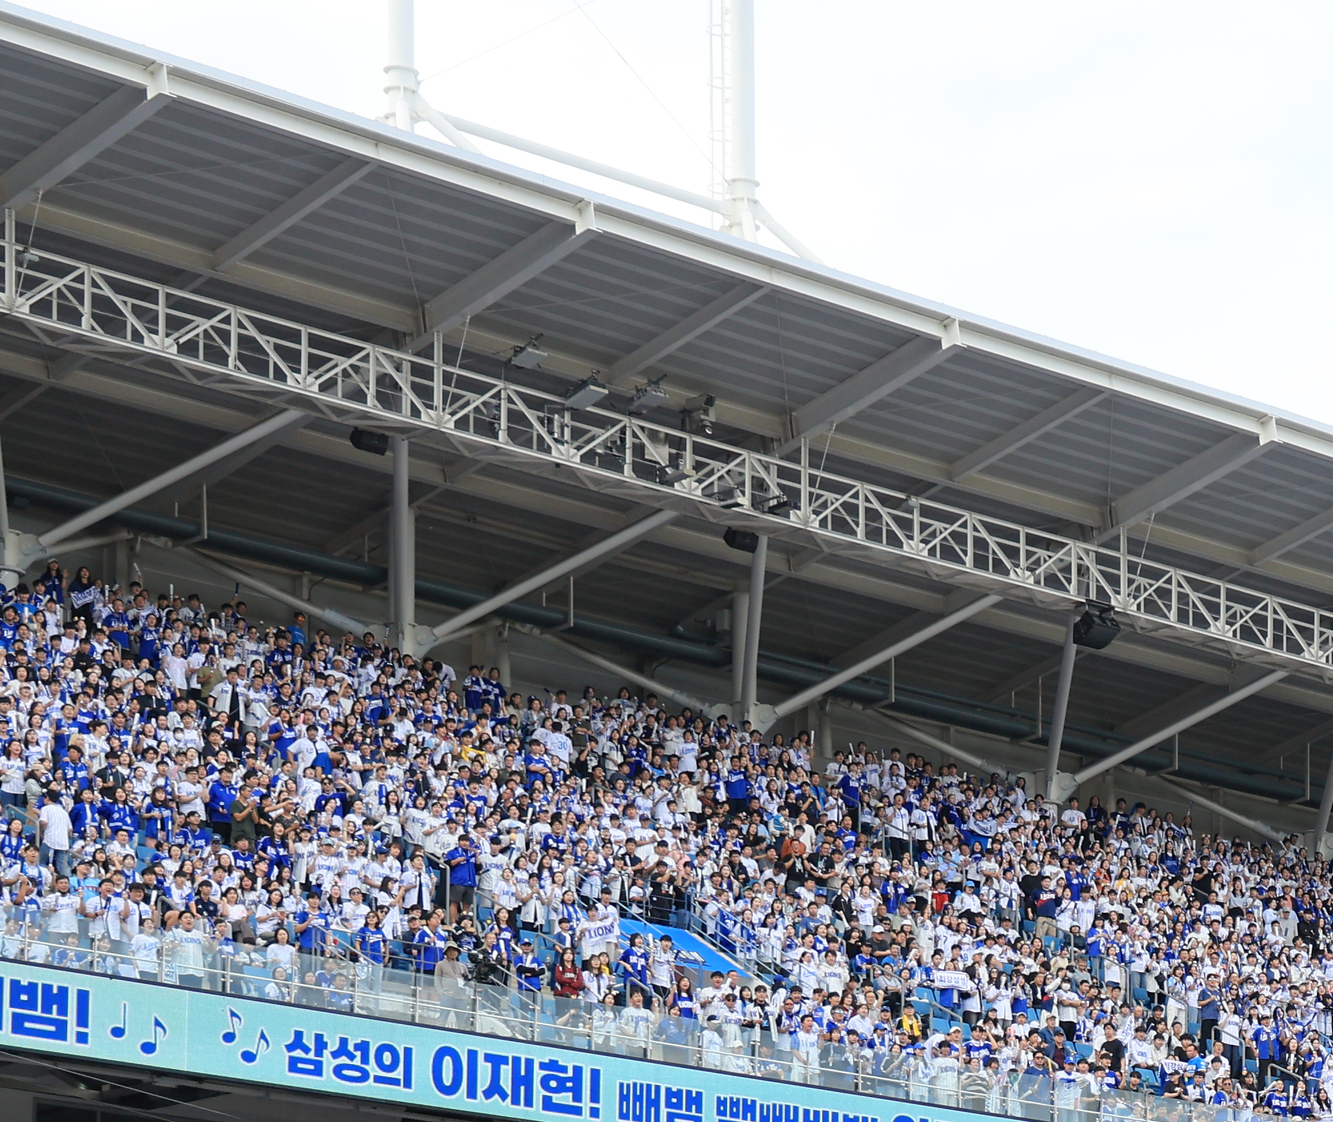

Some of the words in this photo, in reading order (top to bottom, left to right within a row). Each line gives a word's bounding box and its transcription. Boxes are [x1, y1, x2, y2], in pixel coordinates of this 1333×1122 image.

[0, 976, 91, 1045] 뱀!
[285, 1029, 413, 1090] 삼성의
[431, 1045, 601, 1119] 이재현!
